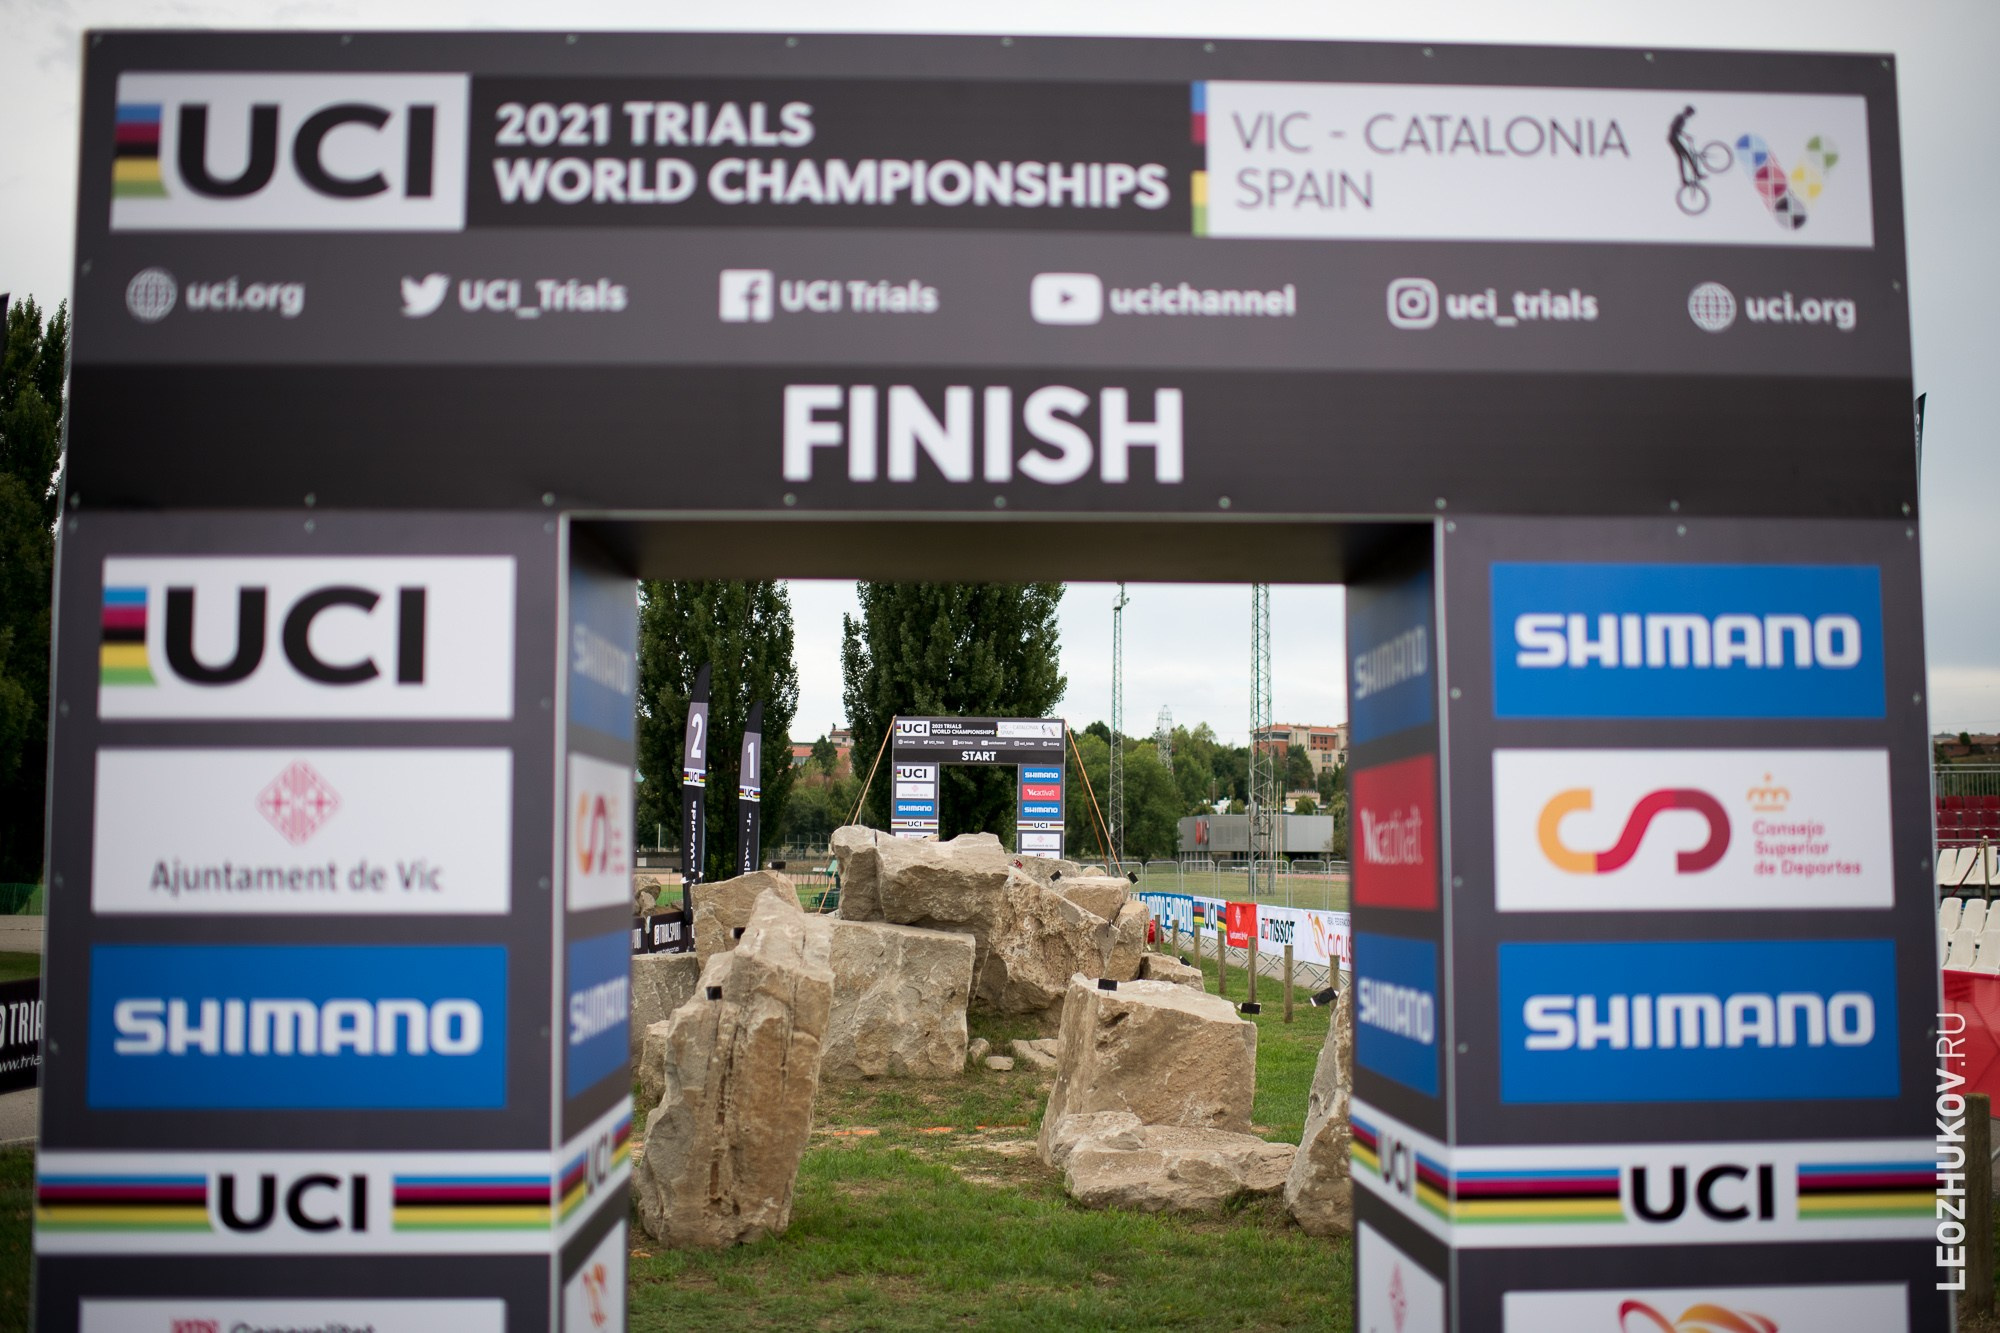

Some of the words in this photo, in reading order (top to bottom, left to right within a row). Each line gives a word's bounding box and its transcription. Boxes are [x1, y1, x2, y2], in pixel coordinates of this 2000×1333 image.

[495, 101, 612, 146] 2021
[621, 102, 814, 149] TRIALS
[1233, 111, 1312, 154] VIC
[1363, 114, 1631, 160] CATALONIA
[175, 102, 436, 199] UCI
[493, 156, 695, 204] WORLD
[706, 157, 1169, 209] CHAMPIONSHIPS
[1234, 168, 1374, 210] SPAIN
[186, 277, 305, 317] uci.org
[458, 278, 628, 318] UCI_Trials
[781, 280, 841, 312] UCI
[848, 280, 938, 313] Trials
[1110, 283, 1296, 317] ucichannel
[1446, 287, 1599, 327] uci_trials
[1746, 293, 1856, 332] uci.org
[783, 384, 1184, 484] FINISH
[165, 585, 428, 687] UCI
[1514, 613, 1863, 670] SHIMANO
[691, 713, 703, 758] 2
[902, 723, 927, 734] UCI
[747, 742, 755, 779] 1
[902, 768, 927, 779] UCI
[961, 750, 997, 761] START
[1752, 818, 1824, 843] Consejo
[1754, 840, 1830, 859] Superior
[150, 860, 339, 898] Ajuntament
[349, 860, 386, 891] de
[396, 861, 444, 892] Vic
[1754, 861, 1777, 875] de
[1780, 860, 1862, 878] Deportes
[1204, 902, 1217, 931] UCI
[1269, 918, 1295, 944] TISSOT
[113, 998, 484, 1056] SHIMANO
[1357, 976, 1435, 1046] SHIMANO
[1523, 992, 1875, 1051] SHIMANO
[218, 1173, 369, 1233] UCI
[1630, 1164, 1775, 1224] UCI
